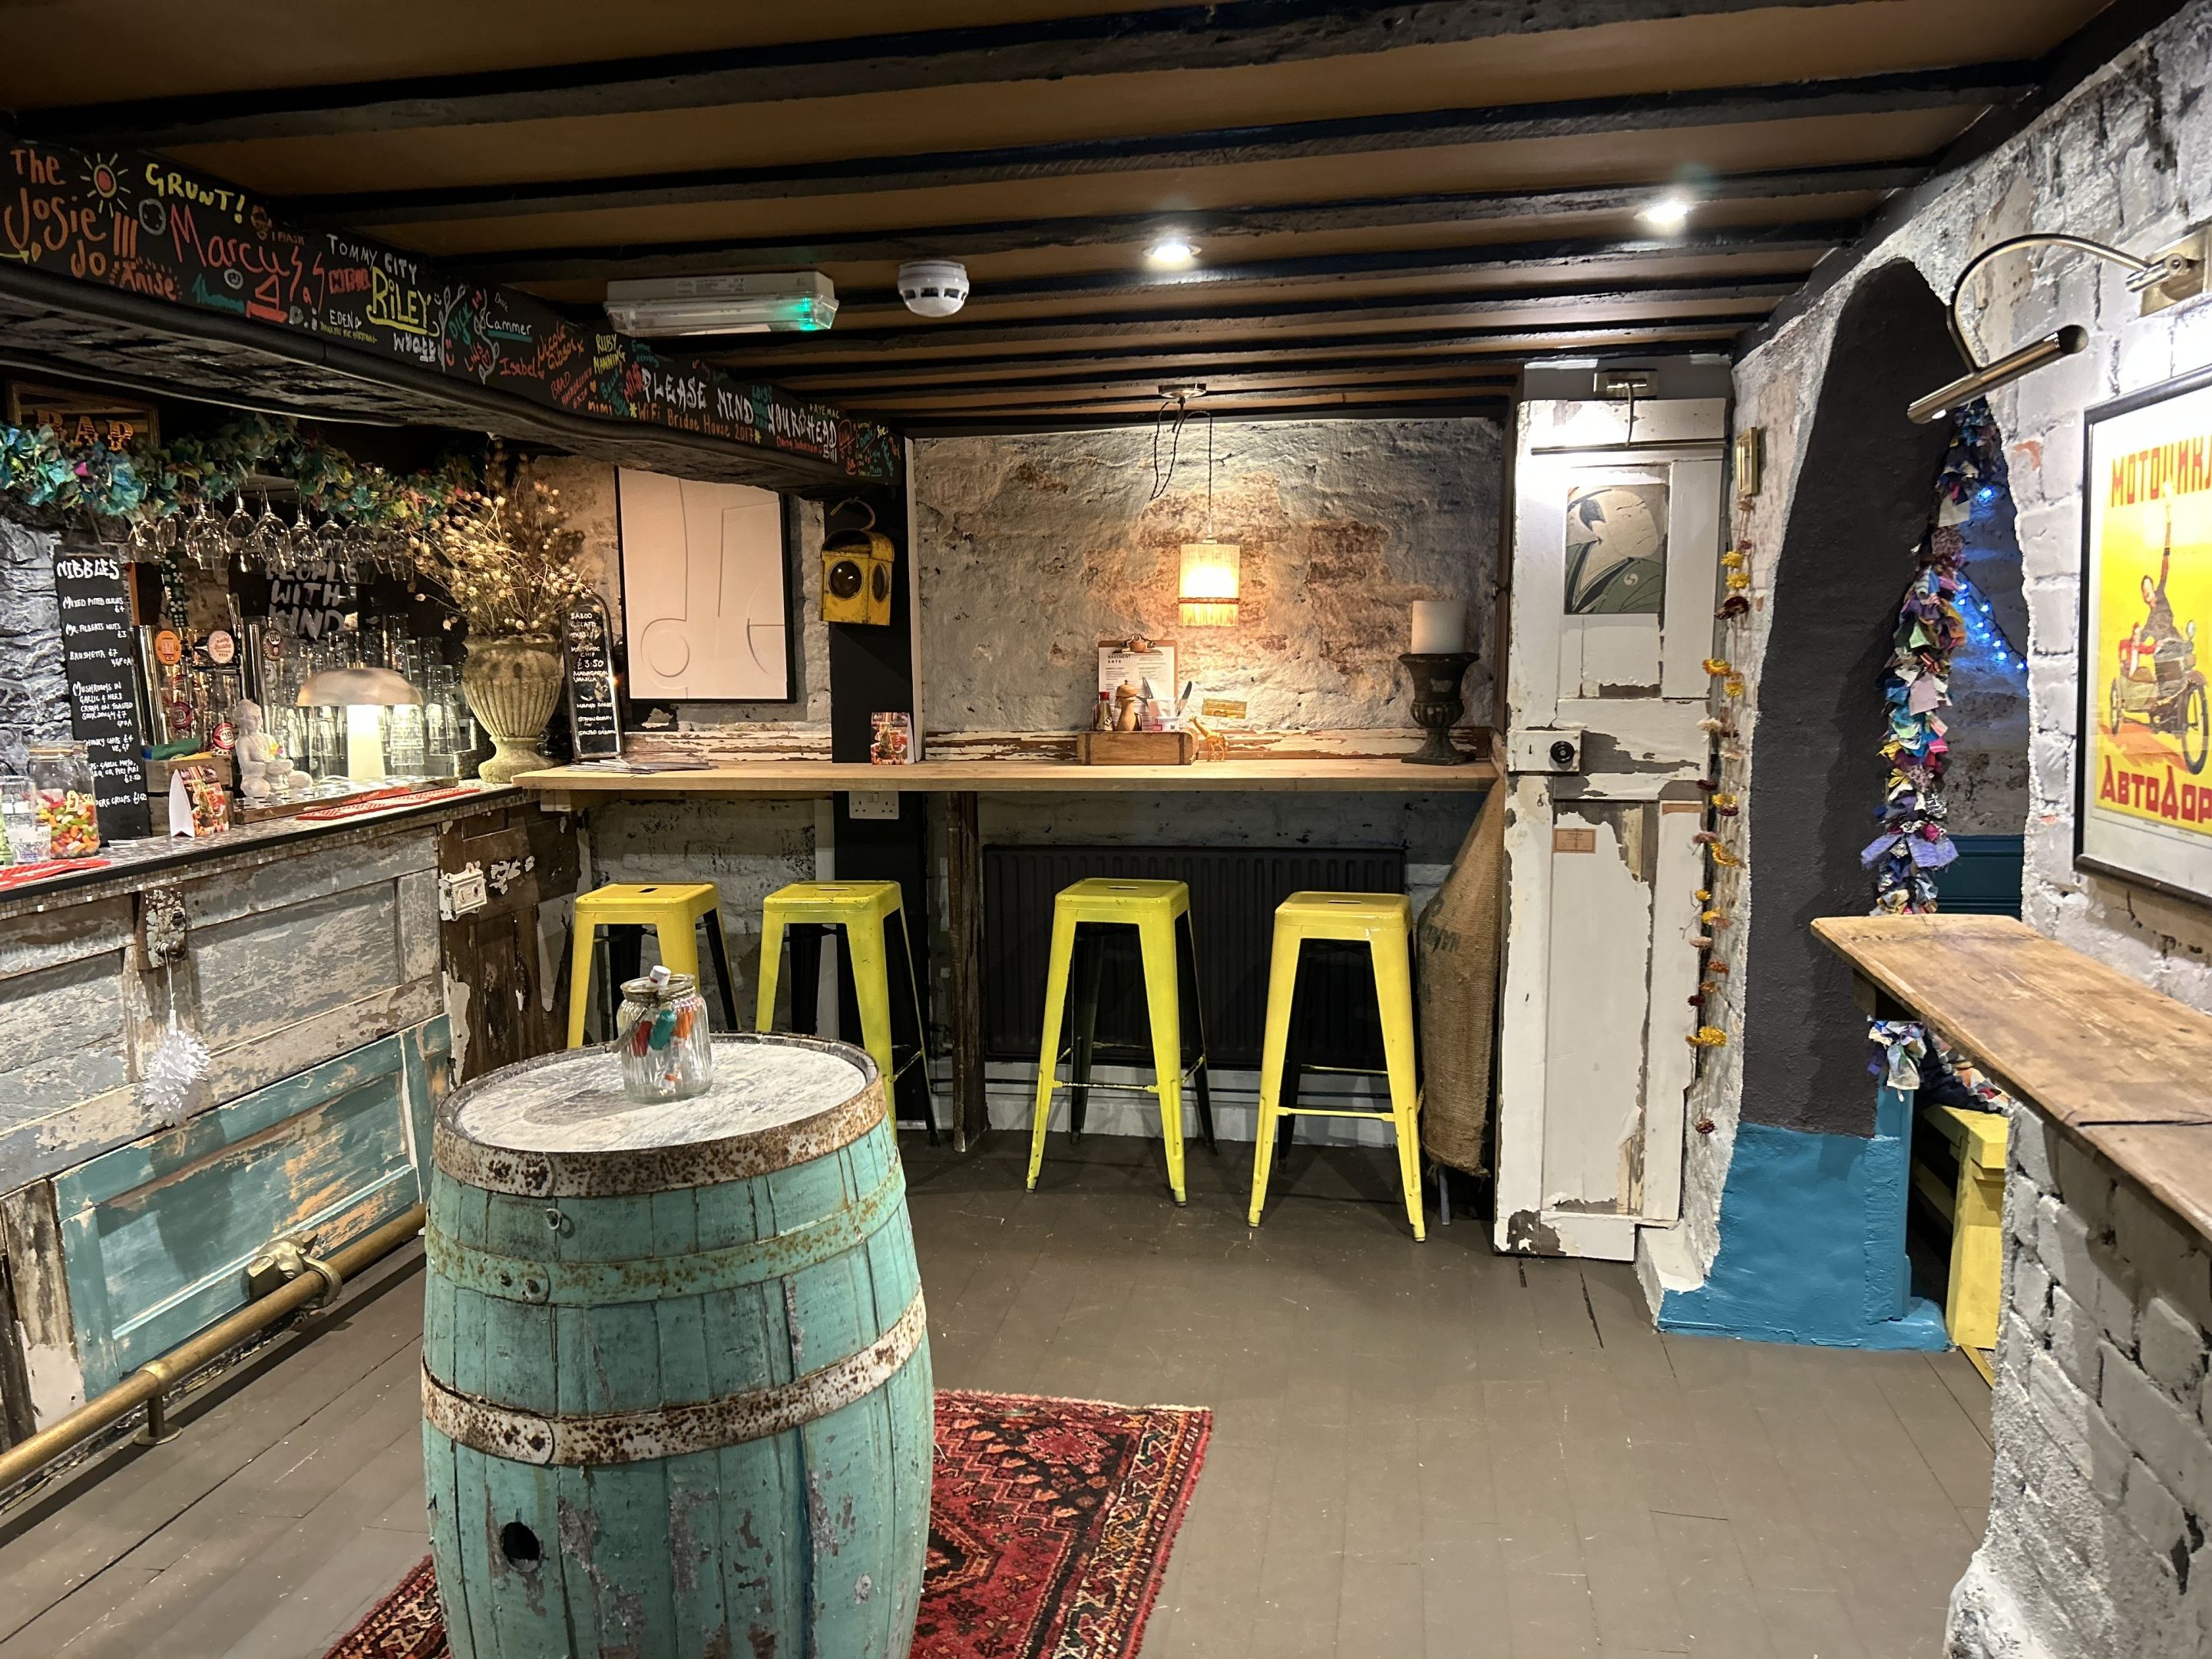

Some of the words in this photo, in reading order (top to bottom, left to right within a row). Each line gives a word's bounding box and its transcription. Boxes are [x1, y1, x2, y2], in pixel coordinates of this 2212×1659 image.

[9, 148, 67, 186] The
[145, 163, 246, 224] GRUNT!
[4, 187, 107, 251] Josie
[71, 239, 107, 279] Jo
[326, 233, 378, 269] TOMMY
[385, 252, 418, 286] CITY
[329, 309, 354, 329] EDEN
[485, 311, 532, 335] Cammer
[596, 333, 617, 355] RUBY
[499, 357, 537, 378] Isabel
[593, 344, 627, 375] MANNING
[641, 367, 707, 413] PLEASE
[716, 386, 754, 425] MIND
[768, 403, 801, 438] YOUR
[806, 415, 837, 449] HEAD
[826, 407, 840, 420] MAC
[638, 401, 662, 421] WiFi
[666, 408, 700, 431] Bridge
[703, 414, 730, 438] House
[735, 423, 754, 444] 2017
[823, 444, 837, 464] Bill
[57, 558, 120, 580] NIBBLES
[63, 596, 86, 609] MIXED
[271, 580, 340, 607] WITH
[117, 630, 127, 639] £3
[108, 648, 118, 657] £7
[72, 681, 112, 696] MUSHROOMS
[117, 710, 127, 719] £7
[124, 734, 134, 743] £4
